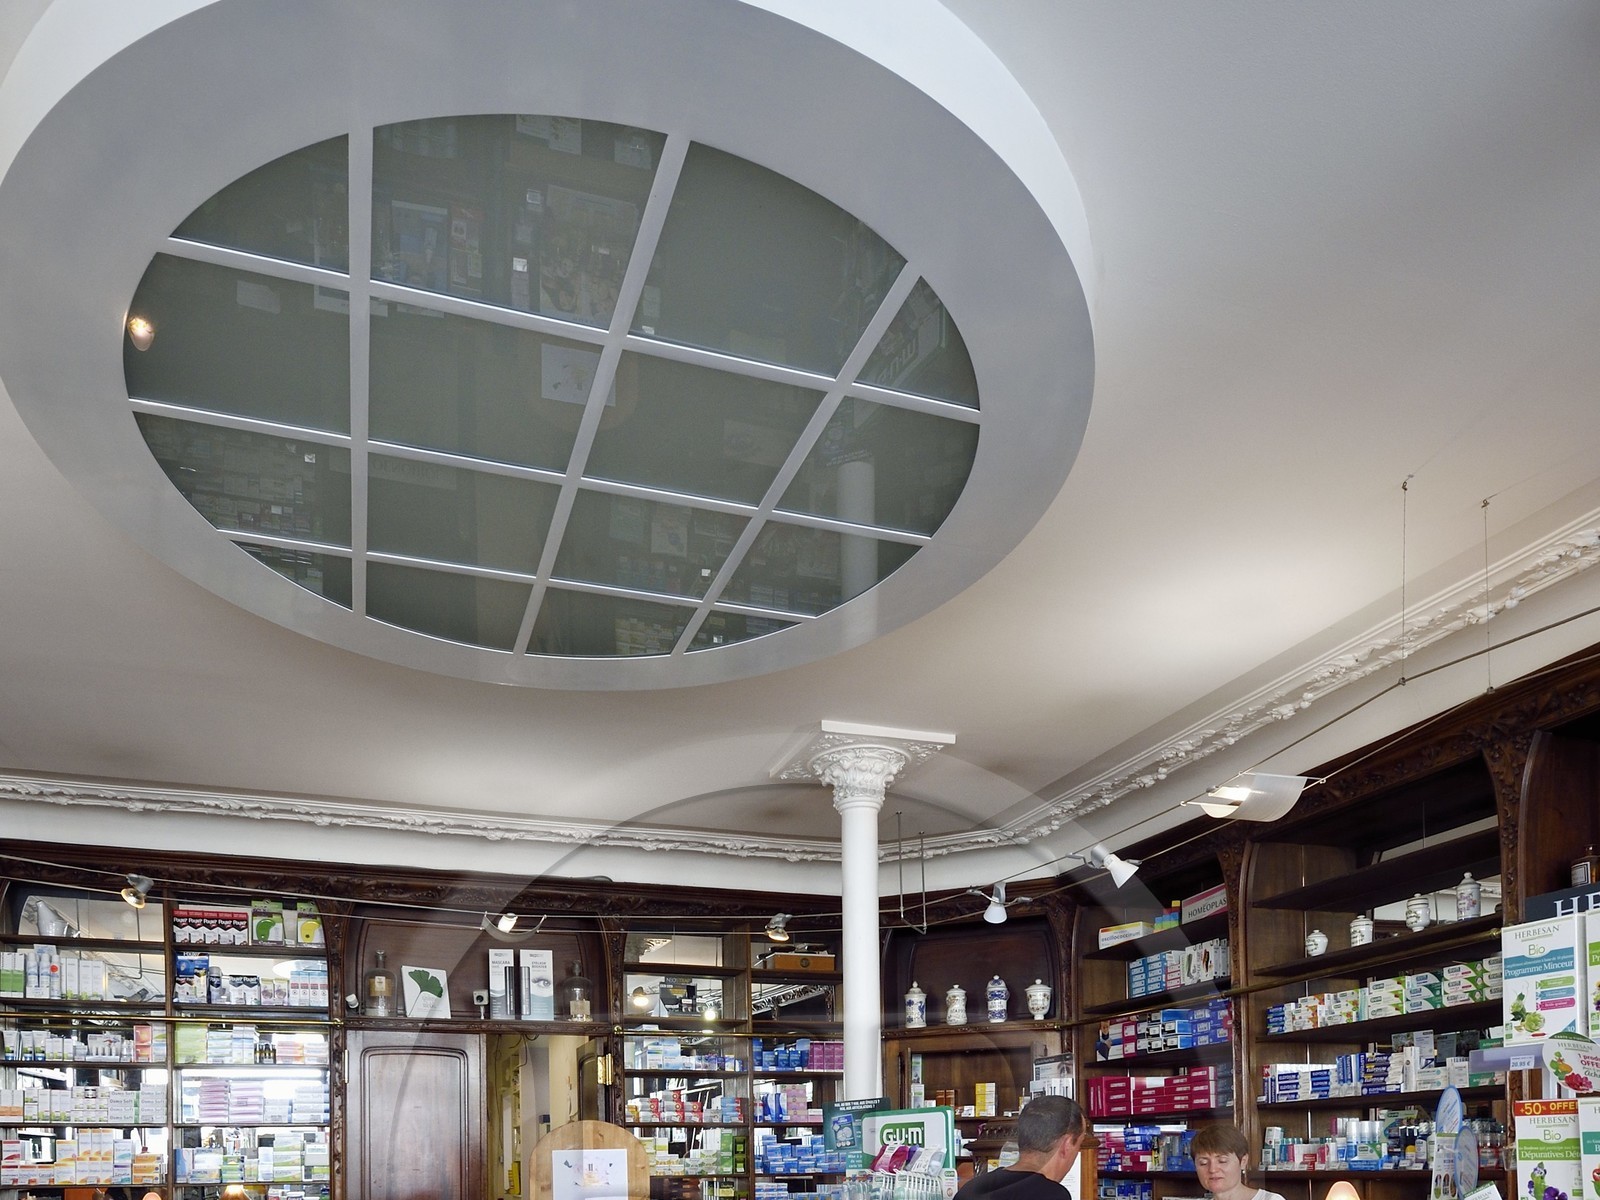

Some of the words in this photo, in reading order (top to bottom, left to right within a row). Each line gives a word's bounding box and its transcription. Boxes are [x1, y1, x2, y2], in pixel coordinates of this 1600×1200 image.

[1514, 925, 1560, 940] HERBESAN
[1528, 943, 1546, 955] Bio
[1504, 965, 1543, 977] Programme
[1543, 960, 1574, 971] Minceur
[1550, 1101, 1578, 1111] OFFE
[1529, 1116, 1576, 1125] HERBESAN
[1543, 1129, 1562, 1140] Bio
[1521, 1150, 1564, 1160] Dépuratives
